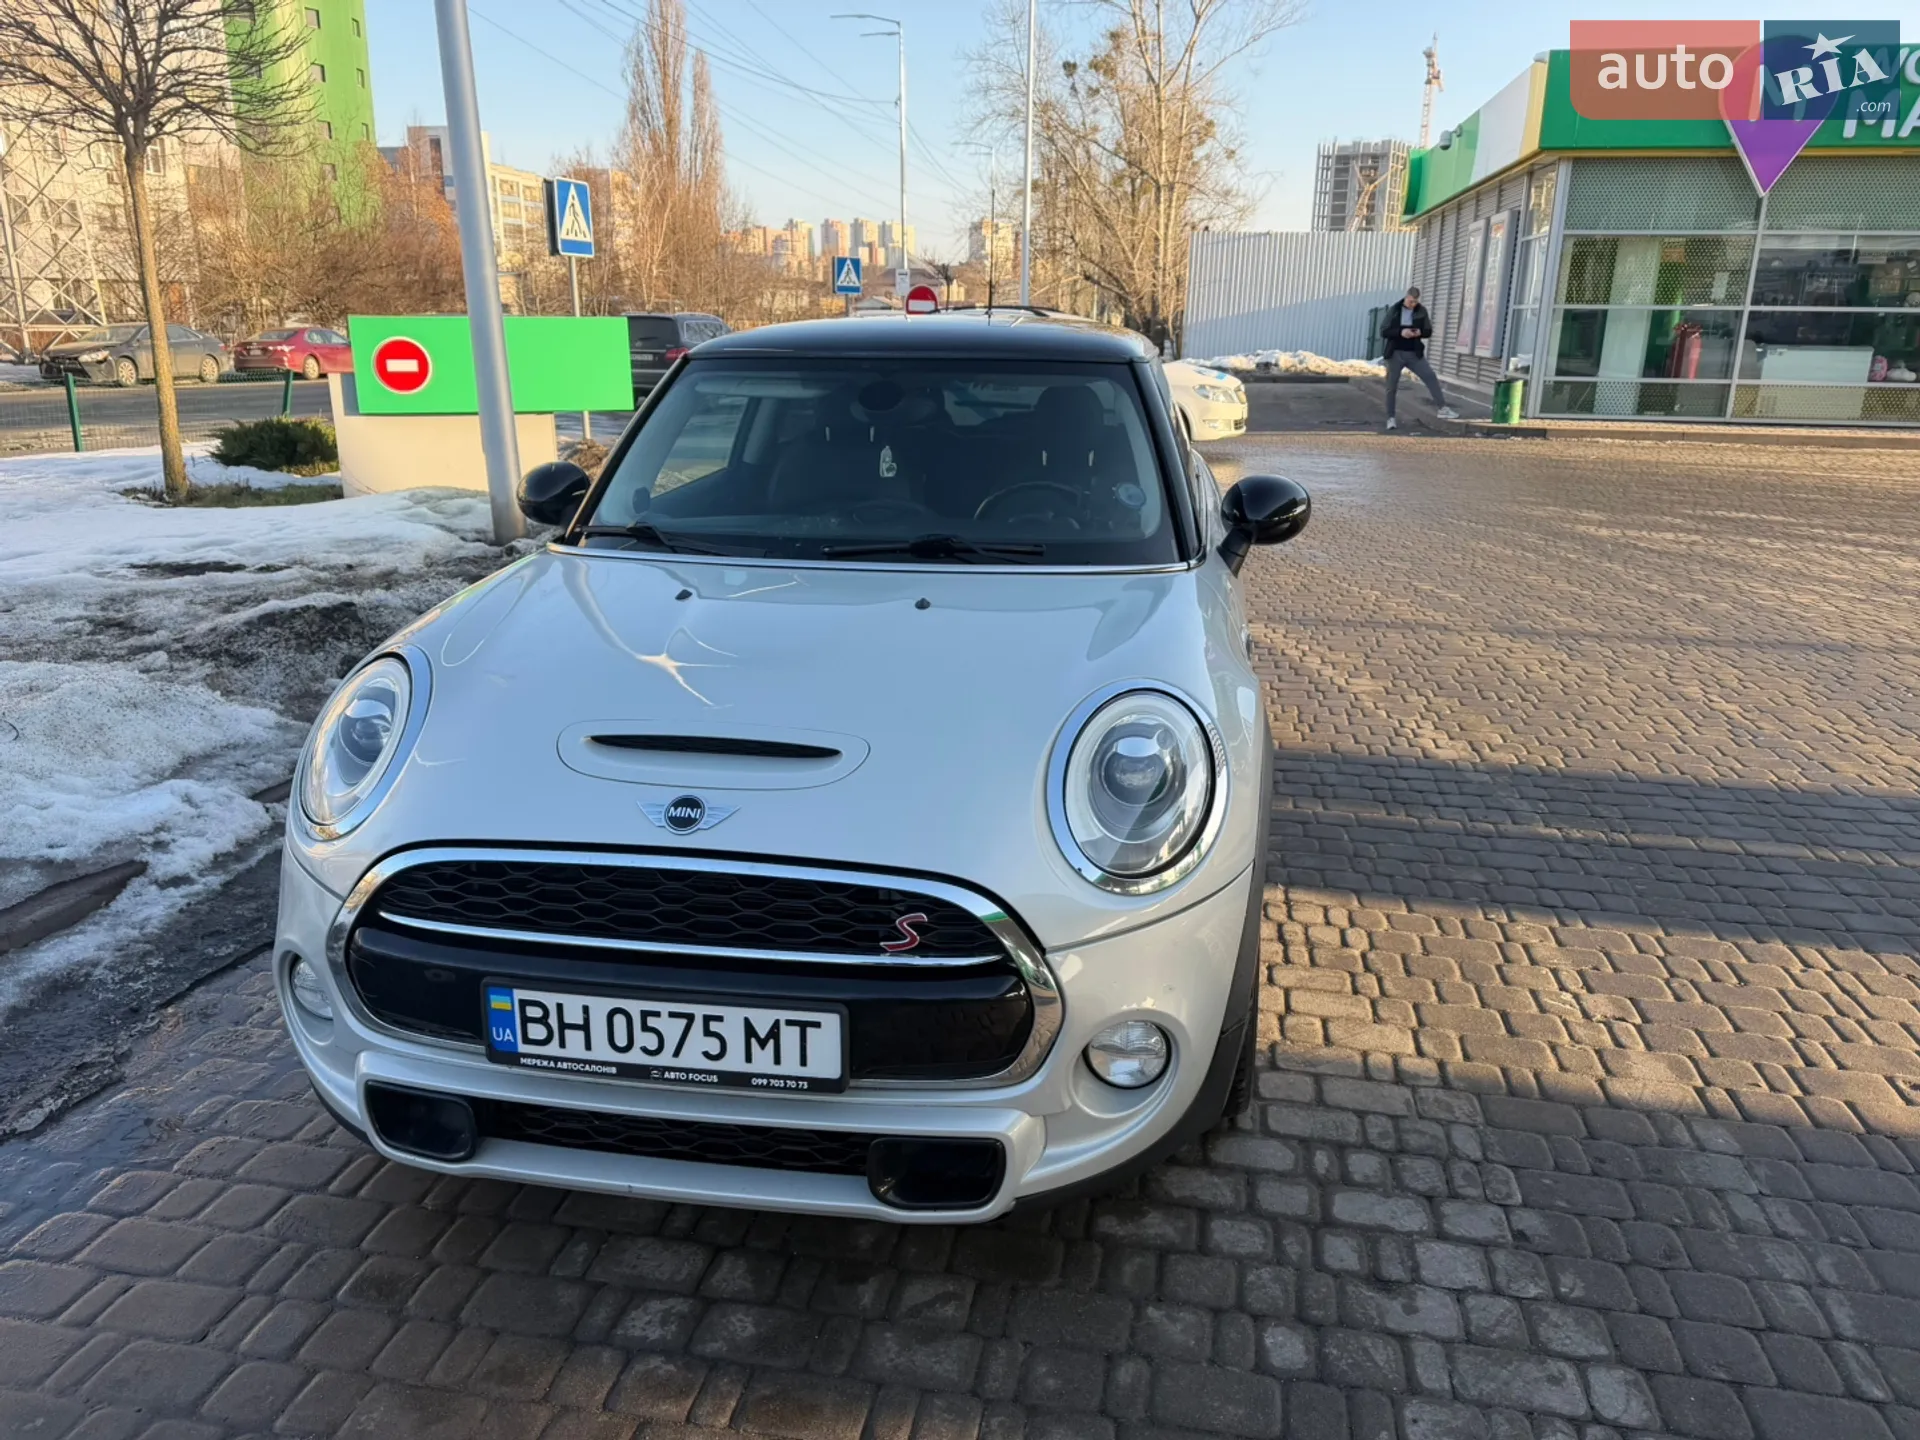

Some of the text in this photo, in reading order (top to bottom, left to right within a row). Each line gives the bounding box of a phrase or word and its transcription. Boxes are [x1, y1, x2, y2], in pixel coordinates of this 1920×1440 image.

[668, 806, 702, 819] MINI
[879, 912, 928, 952] S
[492, 1027, 515, 1043] UA
[518, 998, 822, 1067] BH 0575 MT
[520, 1057, 617, 1074] МЕРЕЖА АВТОСАЛОНІВ
[688, 1073, 719, 1083] FOCUS
[751, 1077, 808, 1089] 099 703 70 73
